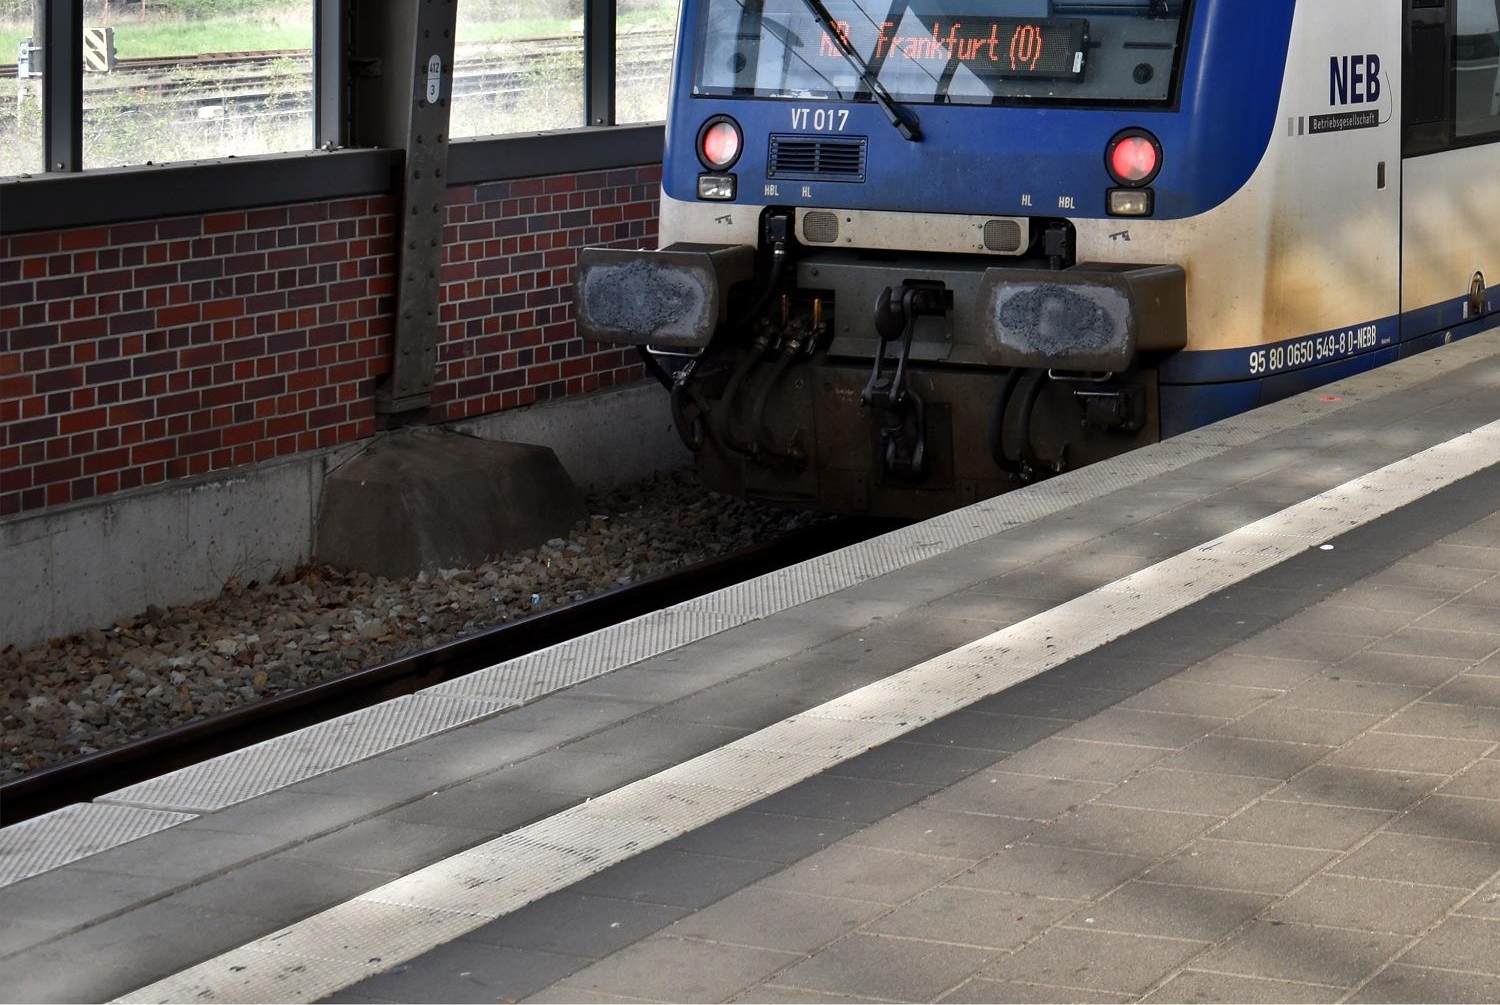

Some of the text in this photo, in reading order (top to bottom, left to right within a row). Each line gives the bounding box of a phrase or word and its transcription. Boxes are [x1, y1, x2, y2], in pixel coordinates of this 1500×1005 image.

[875, 21, 999, 61] Frankfurt
[1329, 54, 1380, 106] NEB
[1313, 112, 1375, 130] Betriebsgesellschaft
[764, 184, 779, 196] HBL
[801, 186, 812, 198] HL
[1021, 194, 1032, 206] HL
[1058, 196, 1075, 209] HBL
[1250, 325, 1377, 374] 95 80 0650 549-8 D-NEBB
